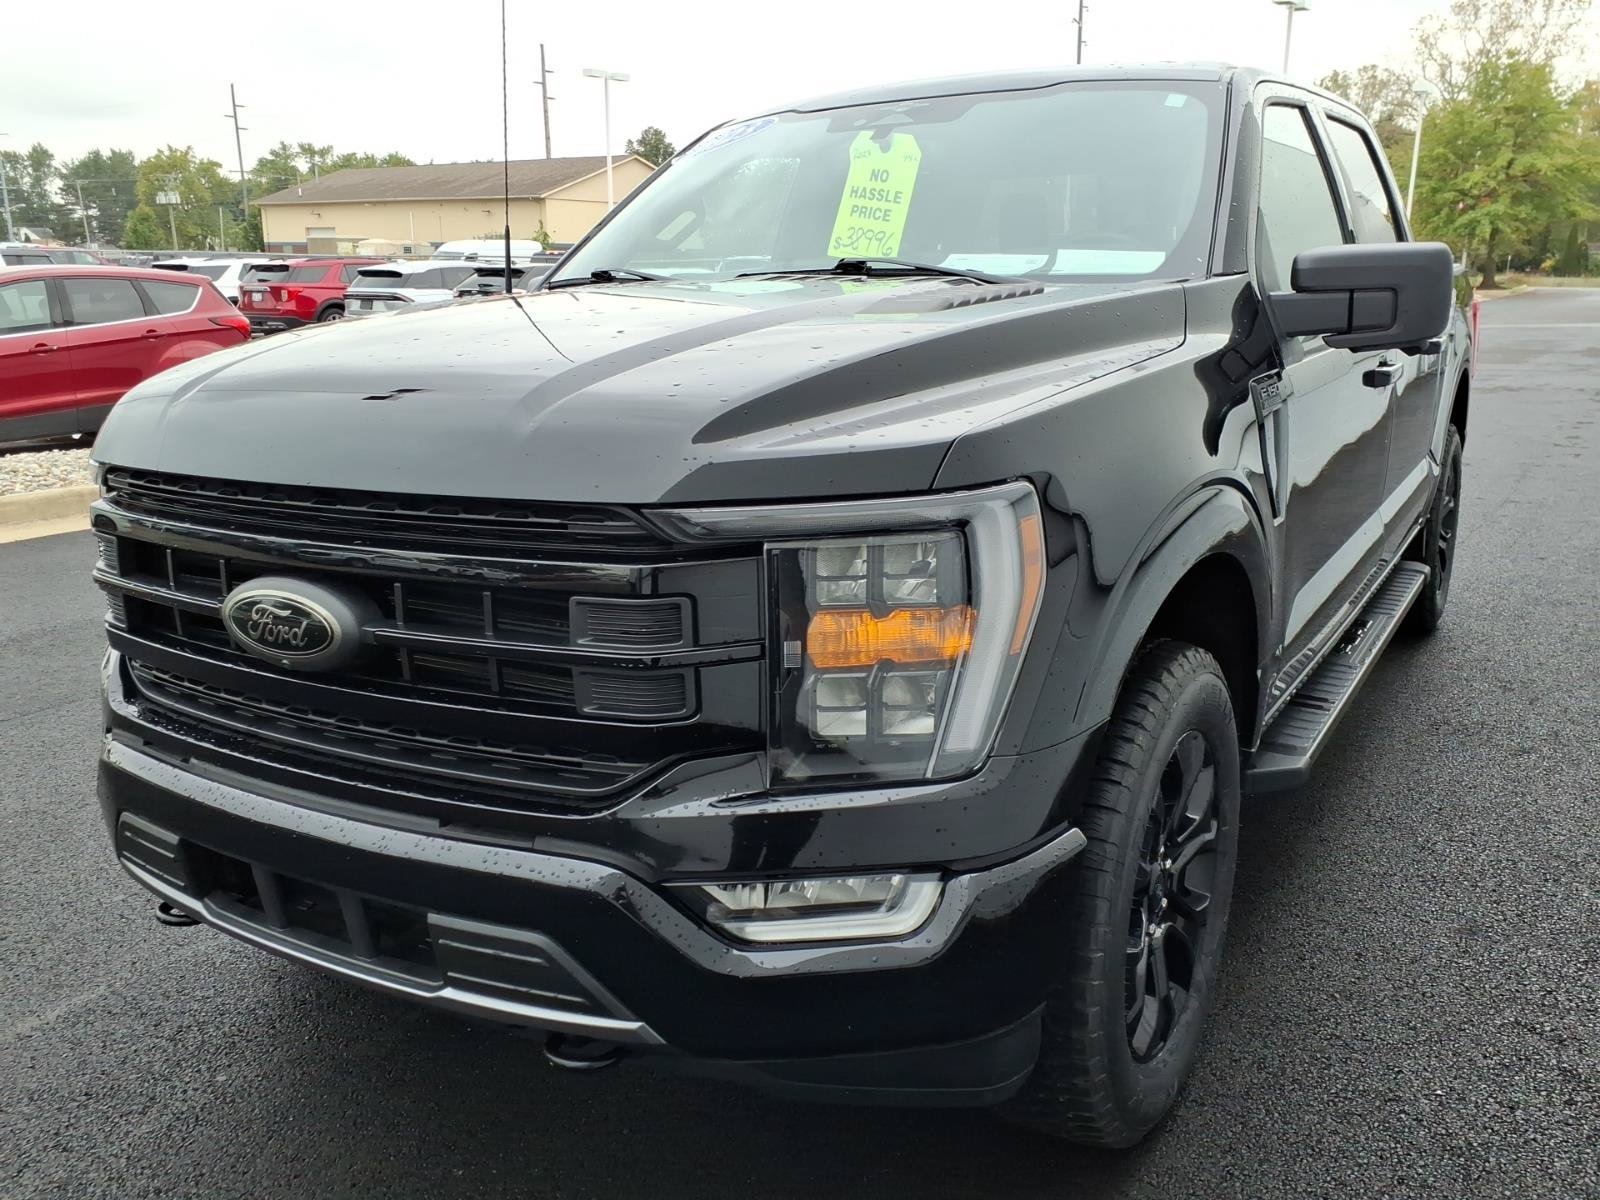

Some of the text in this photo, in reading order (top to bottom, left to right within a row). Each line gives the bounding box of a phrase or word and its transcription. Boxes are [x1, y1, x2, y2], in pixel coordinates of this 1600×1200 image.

[869, 169, 889, 183] NO
[850, 186, 903, 204] HASSLE
[850, 205, 892, 222] PRICE
[247, 604, 308, 647] Ford
